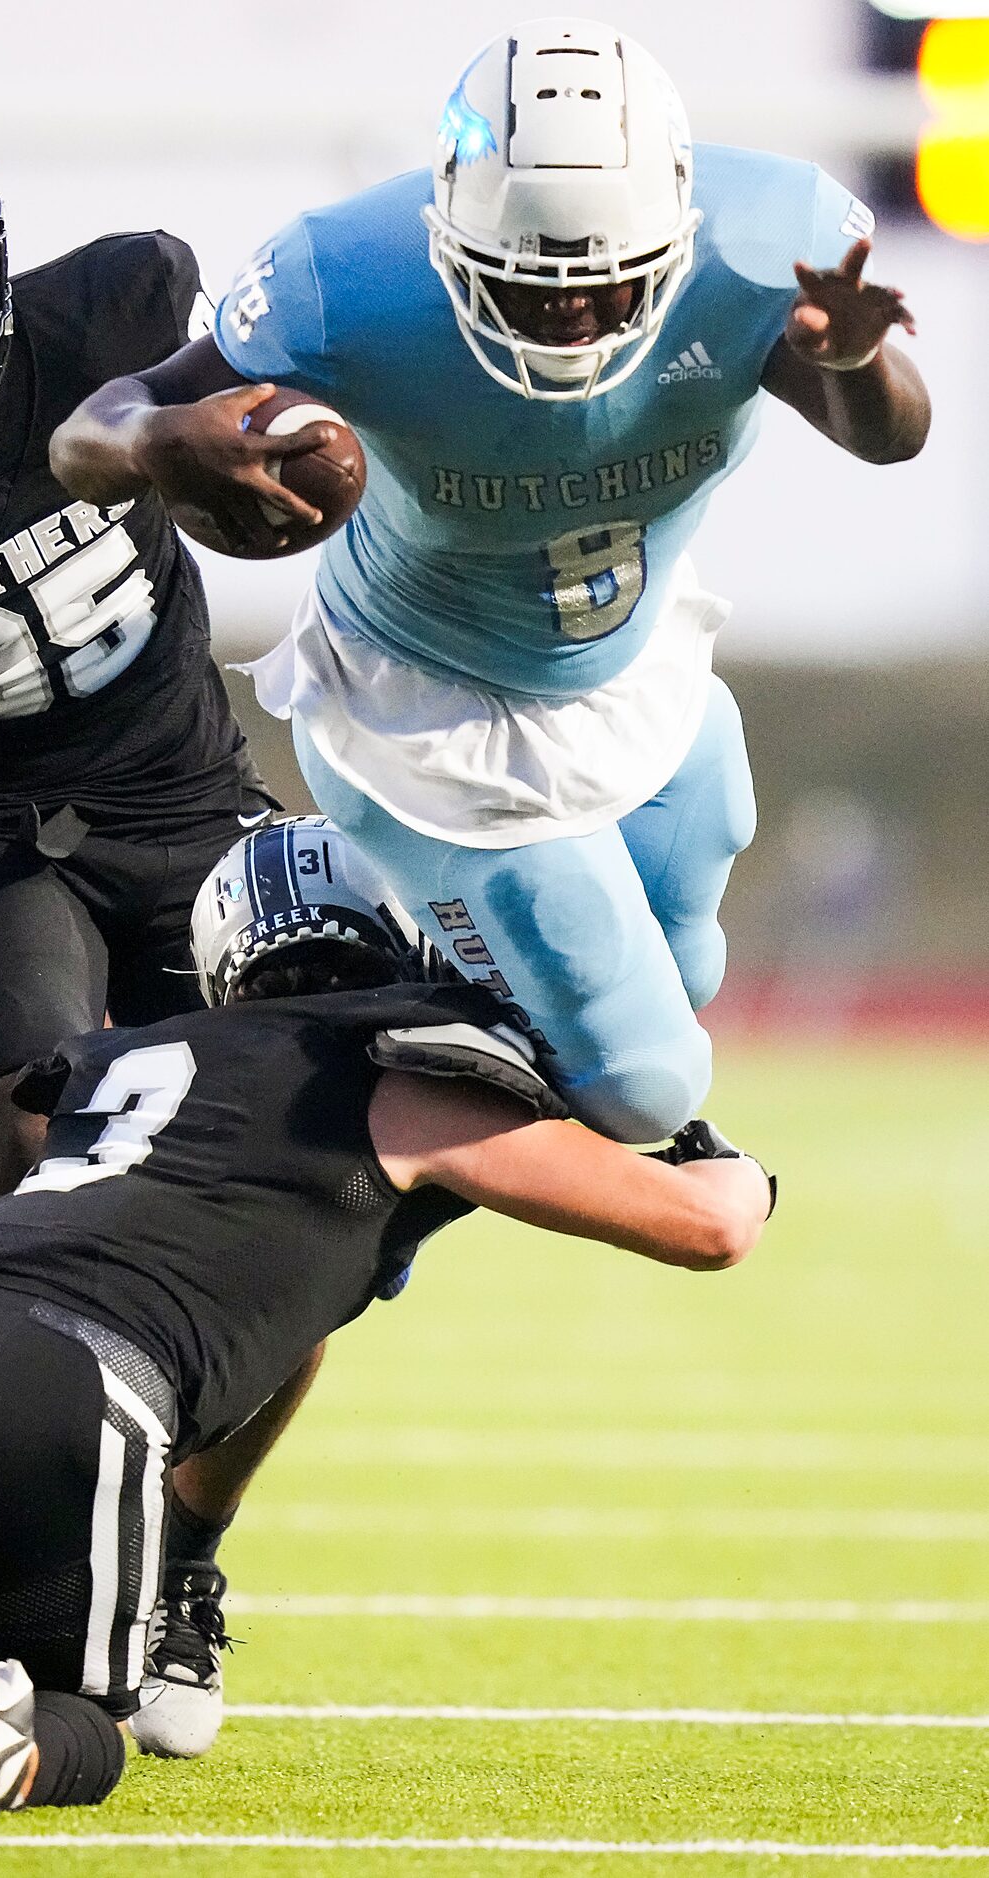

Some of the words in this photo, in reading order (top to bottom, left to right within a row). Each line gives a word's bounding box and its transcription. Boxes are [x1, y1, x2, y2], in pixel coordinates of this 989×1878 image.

[657, 365, 722, 385] adidas
[432, 430, 720, 512] HUTCHINS
[544, 520, 648, 643] 8
[297, 848, 320, 876] 3
[13, 1041, 198, 1196] 3
